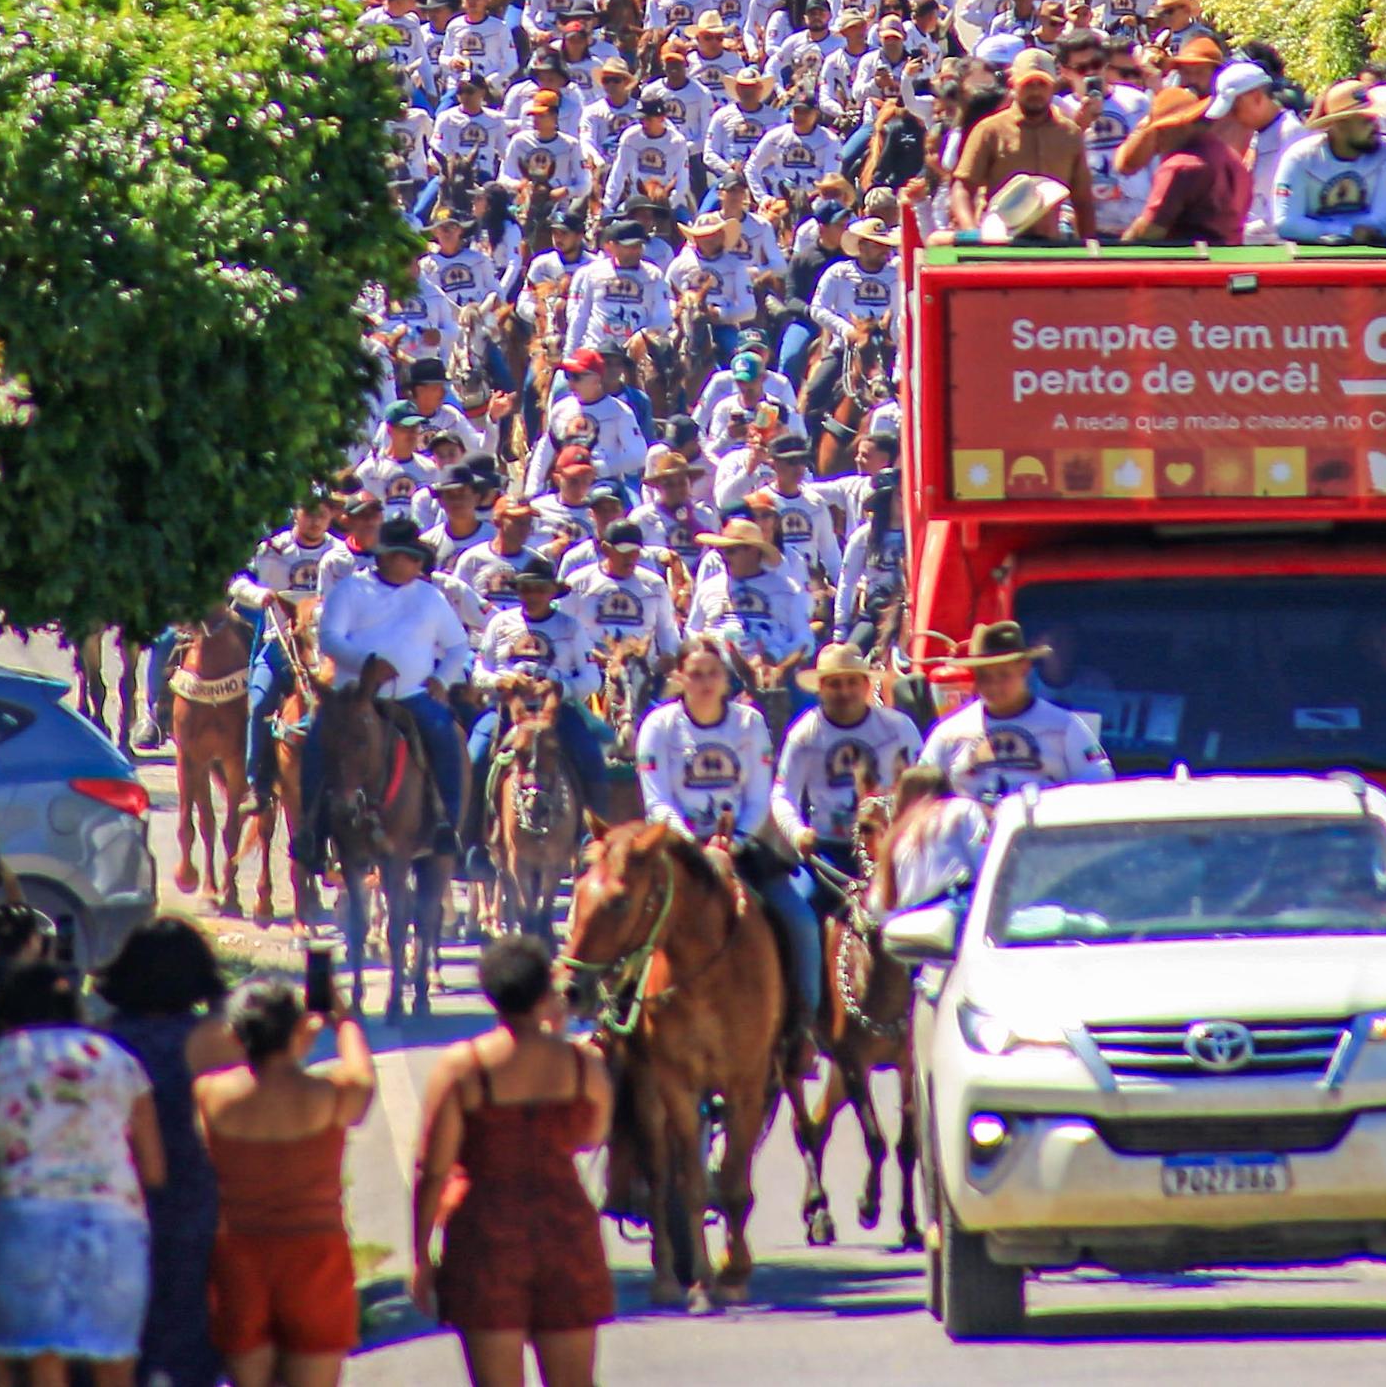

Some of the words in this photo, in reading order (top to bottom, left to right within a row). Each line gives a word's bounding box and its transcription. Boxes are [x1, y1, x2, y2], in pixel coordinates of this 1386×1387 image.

[1012, 318, 1178, 357] Sempre
[1188, 320, 1273, 349] tem
[1283, 323, 1348, 349] um
[1013, 365, 1131, 402] perto
[1141, 362, 1196, 395] de
[1206, 361, 1320, 394] você!
[1053, 413, 1070, 430] A
[1075, 412, 1129, 430] rede
[1135, 415, 1179, 434] que
[1184, 412, 1238, 430] mais
[1245, 413, 1329, 430] cresce
[1333, 416, 1363, 430] no
